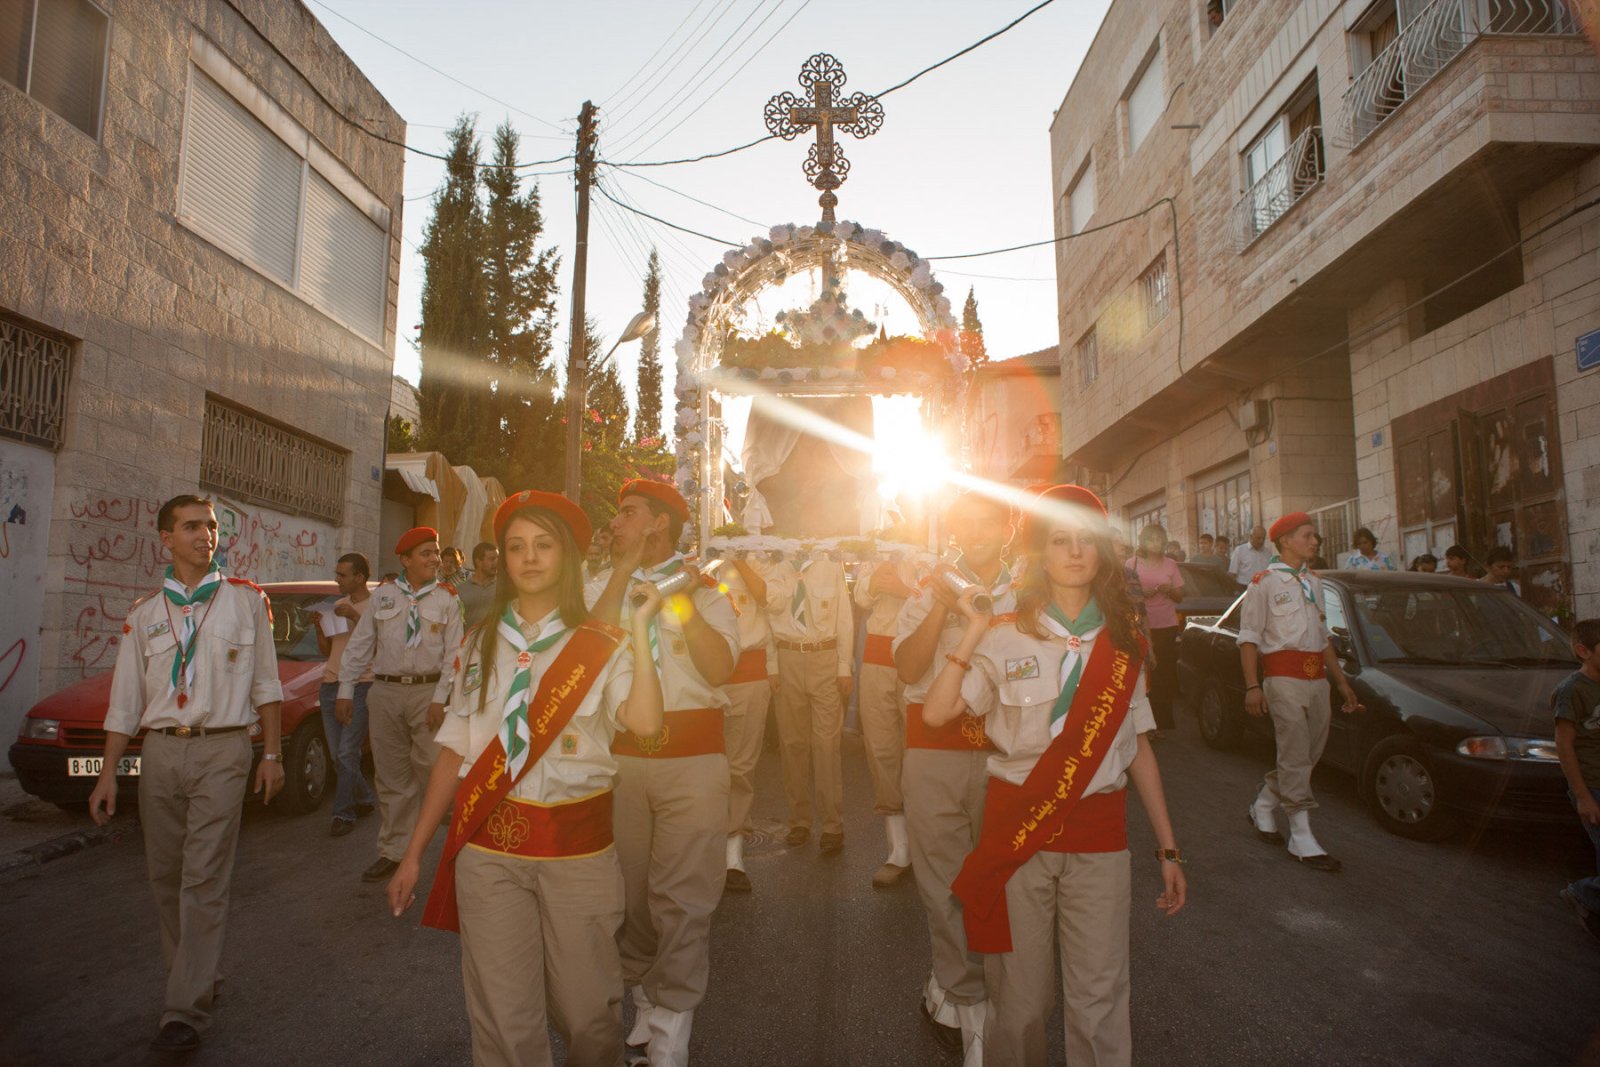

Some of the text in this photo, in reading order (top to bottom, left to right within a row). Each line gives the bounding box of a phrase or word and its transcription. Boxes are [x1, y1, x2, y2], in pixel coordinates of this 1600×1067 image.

[550, 663, 586, 699] مجموعة
[1111, 657, 1128, 690] النادي
[535, 695, 561, 735] النادي
[1055, 756, 1079, 799] العربي
[462, 784, 483, 823] العربي
[1030, 800, 1057, 821] بيت
[1012, 819, 1038, 851] ساحور
